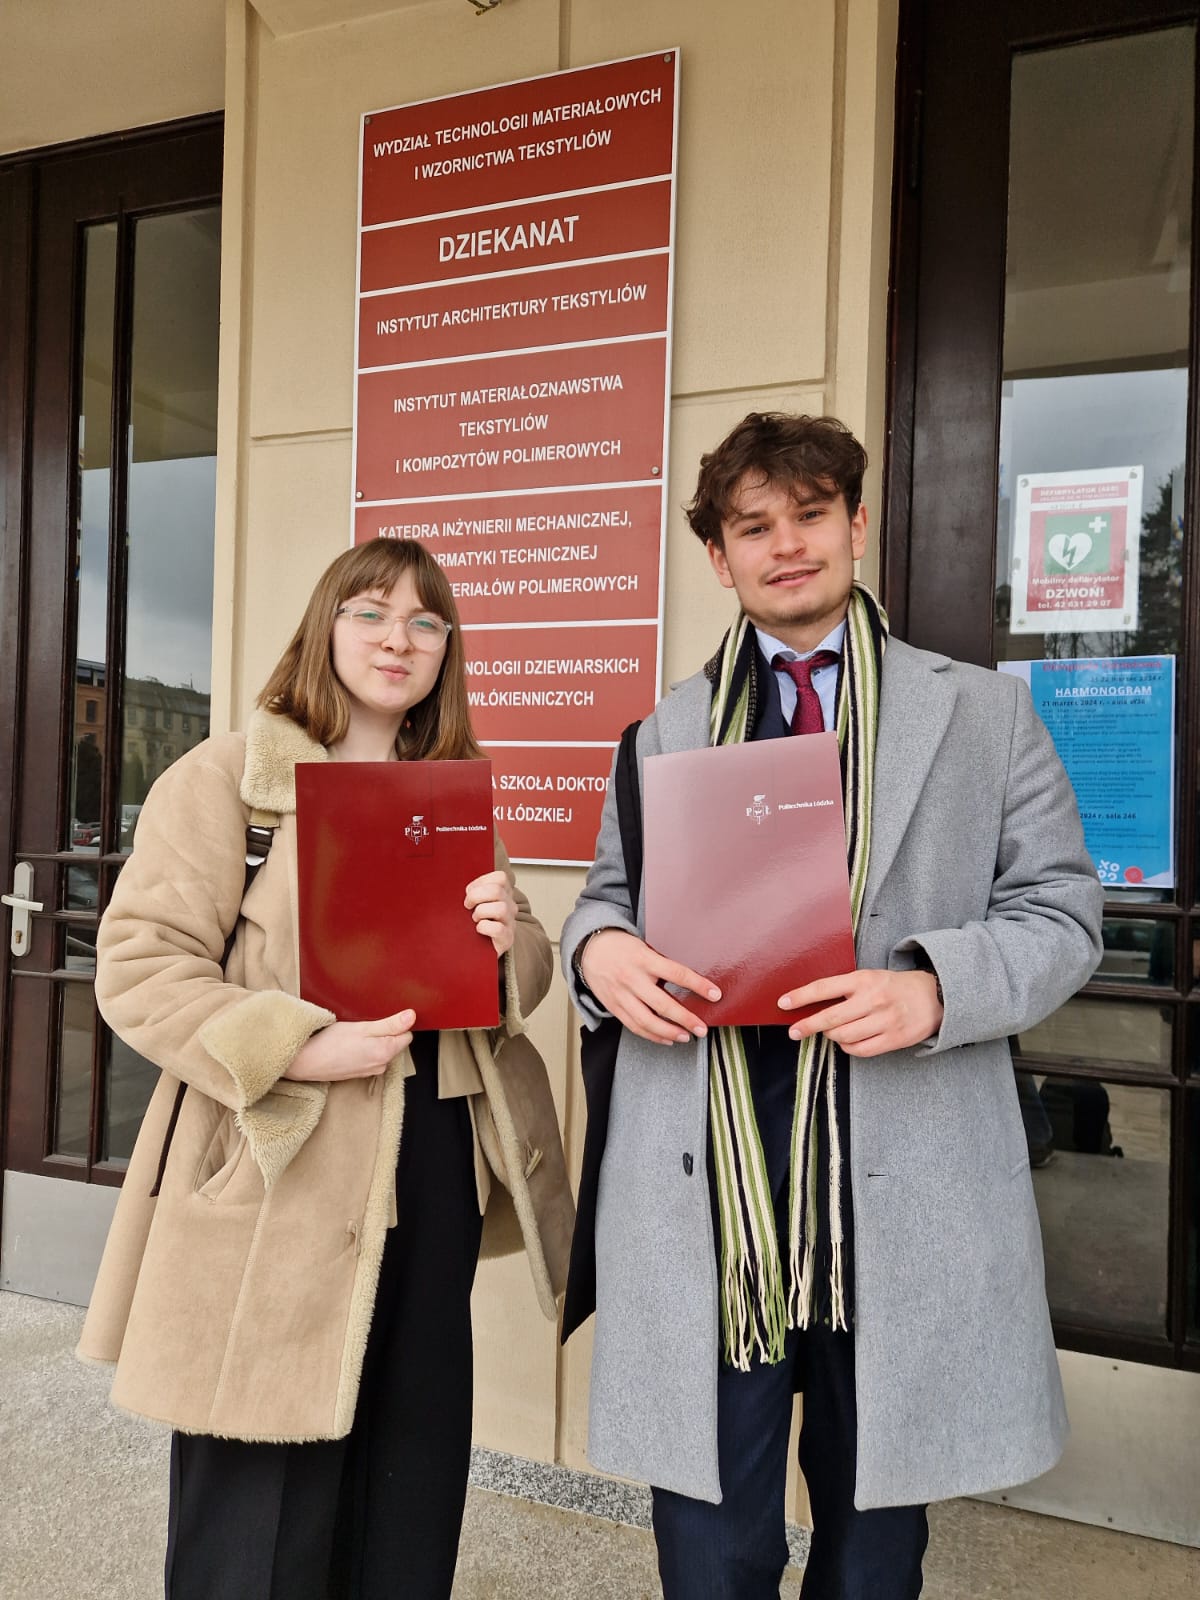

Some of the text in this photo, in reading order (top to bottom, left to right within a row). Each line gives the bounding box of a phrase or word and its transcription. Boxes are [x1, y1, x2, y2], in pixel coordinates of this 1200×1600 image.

[373, 88, 661, 158] WYDZIAŁ TECHNOLOGII MATERIAŁOWYCH
[414, 129, 612, 180] I WZORNICTWA TEKSTYLIÓW
[439, 215, 580, 262] DZIEKANAT
[377, 283, 647, 335] INSTYTUT ARCHITEKTURY TEKSTYLIÓW
[393, 374, 623, 413] INSTYTUT MATERIAŁOZNAWSTWA
[459, 413, 549, 437] TEKSTYLIÓW
[396, 439, 621, 473] I KOMPOZYTÓW POLIMEROWYCH
[378, 510, 632, 539] KATEDRA INŻYNIERII MECHANICZNEJ,
[500, 545, 598, 564] TECHNICZNEJ
[449, 575, 638, 597] ERIAŁÓW POLIMEROWYCH
[1032, 575, 1120, 585] Mobilny defibrylator
[1046, 585, 1105, 599] DZWOŃ!
[525, 658, 639, 675] DZIEWIARSKICH
[467, 688, 594, 706] WŁÓKIENNICZYCH
[1055, 685, 1152, 697] HARMONOGRAM
[500, 775, 554, 791] SZKOŁA
[507, 803, 573, 822] ŁÓDZKIEJ
[746, 807, 752, 816] P
[404, 827, 411, 836] P
